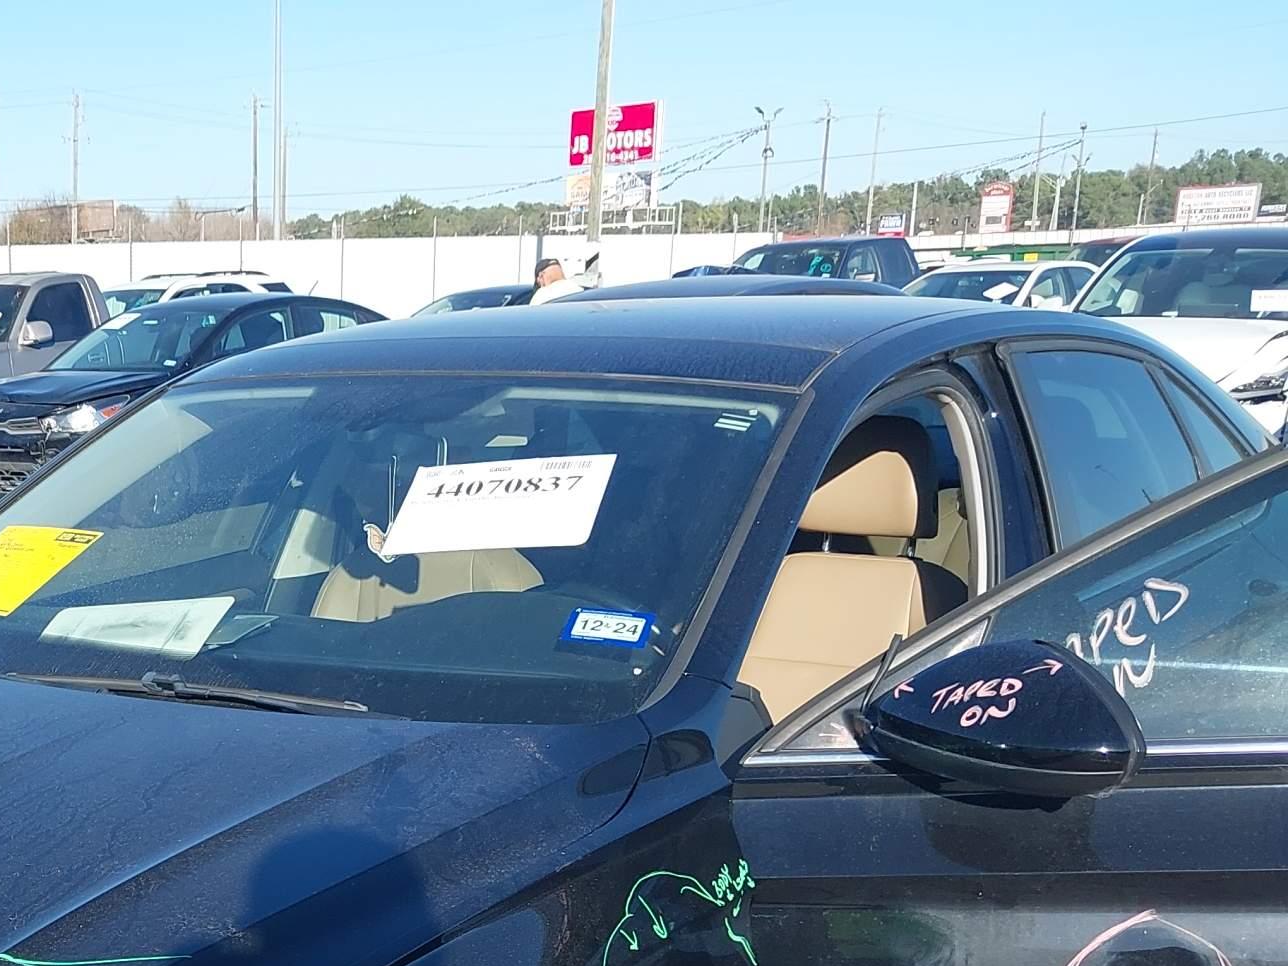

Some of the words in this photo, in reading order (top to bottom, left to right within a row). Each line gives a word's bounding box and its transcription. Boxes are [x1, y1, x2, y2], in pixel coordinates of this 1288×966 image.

[573, 135, 588, 154] JB
[606, 128, 652, 151] OTORS
[427, 475, 584, 498] 44070837
[581, 619, 604, 632] 12
[613, 622, 639, 636] 24
[1065, 577, 1189, 665] APED
[1113, 639, 1156, 698] N
[959, 697, 1016, 727] ON
